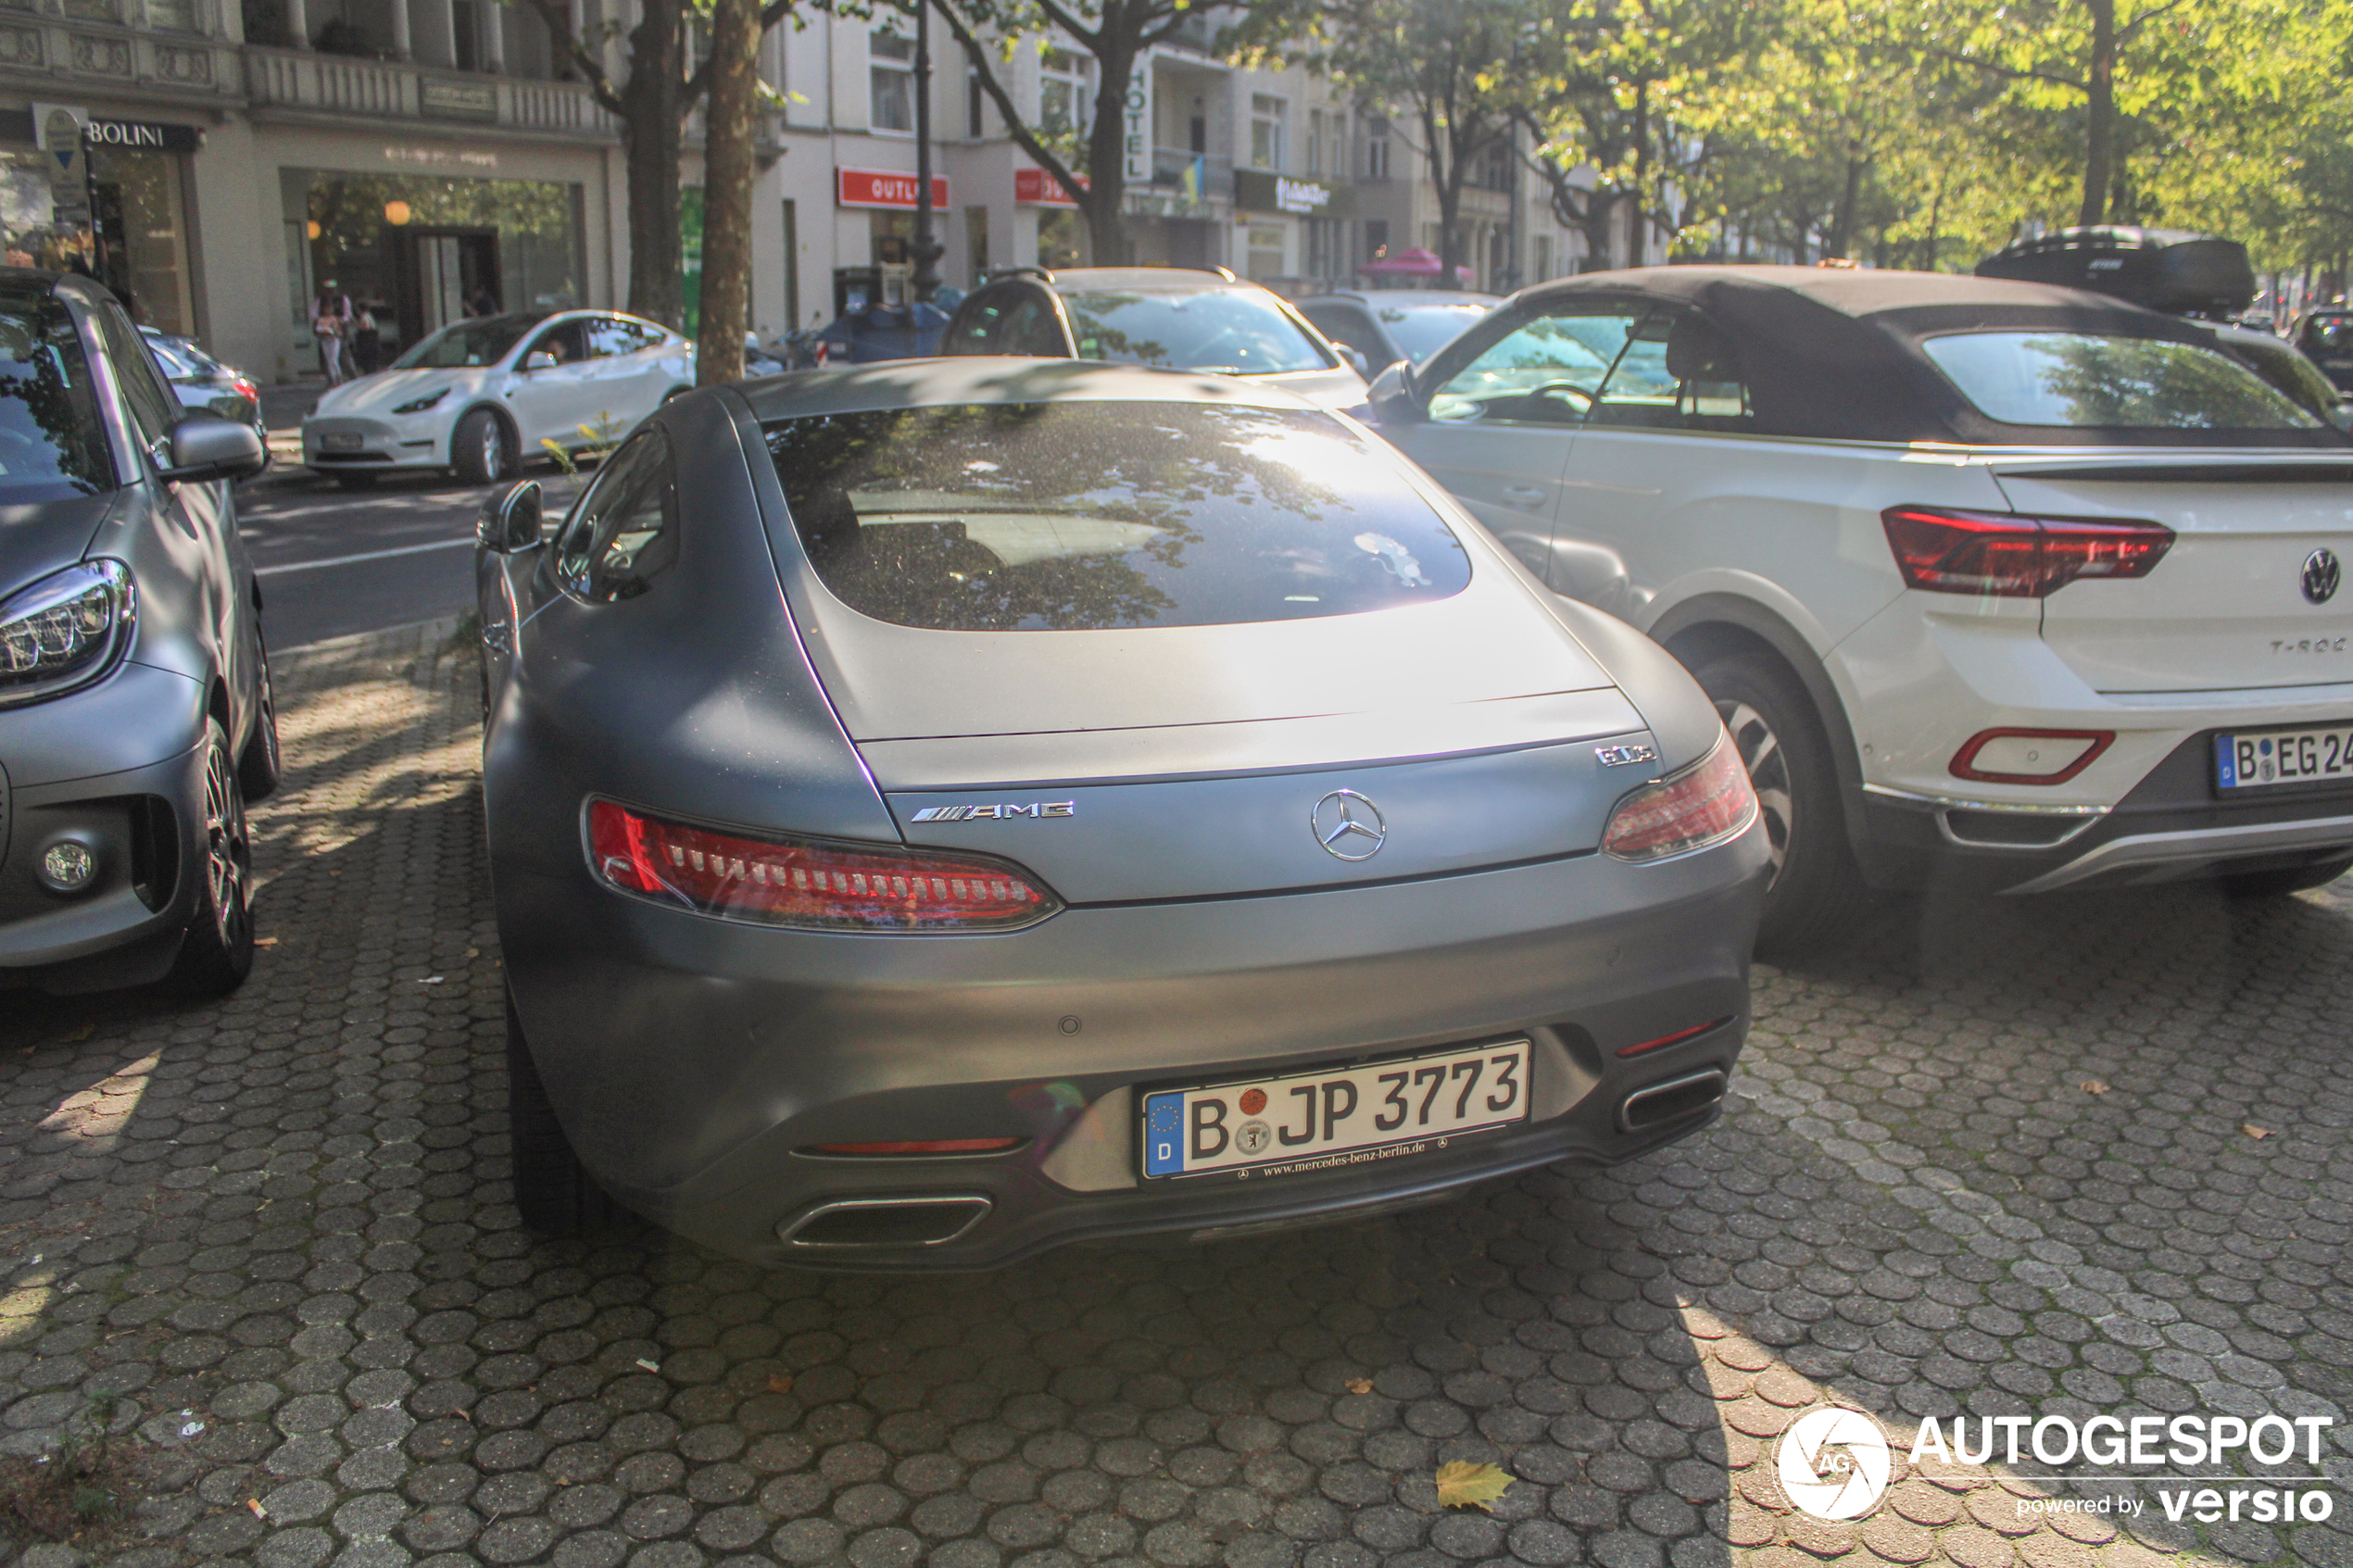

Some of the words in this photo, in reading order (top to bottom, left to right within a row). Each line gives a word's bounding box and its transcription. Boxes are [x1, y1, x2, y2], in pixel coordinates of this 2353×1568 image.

[89, 121, 163, 147] BOLINI
[1126, 69, 1146, 177] HOTEL
[2271, 637, 2347, 654] T-ROC
[2236, 740, 2257, 780] B
[2278, 736, 2318, 777] EG
[963, 801, 1075, 822] AMG
[1190, 1098, 1230, 1160] B
[1277, 1079, 1358, 1148] JP
[1374, 1052, 1520, 1132] 3773
[1157, 1142, 1172, 1161] D
[1263, 1142, 1426, 1178] www.mercedes-benz-berlin.de
